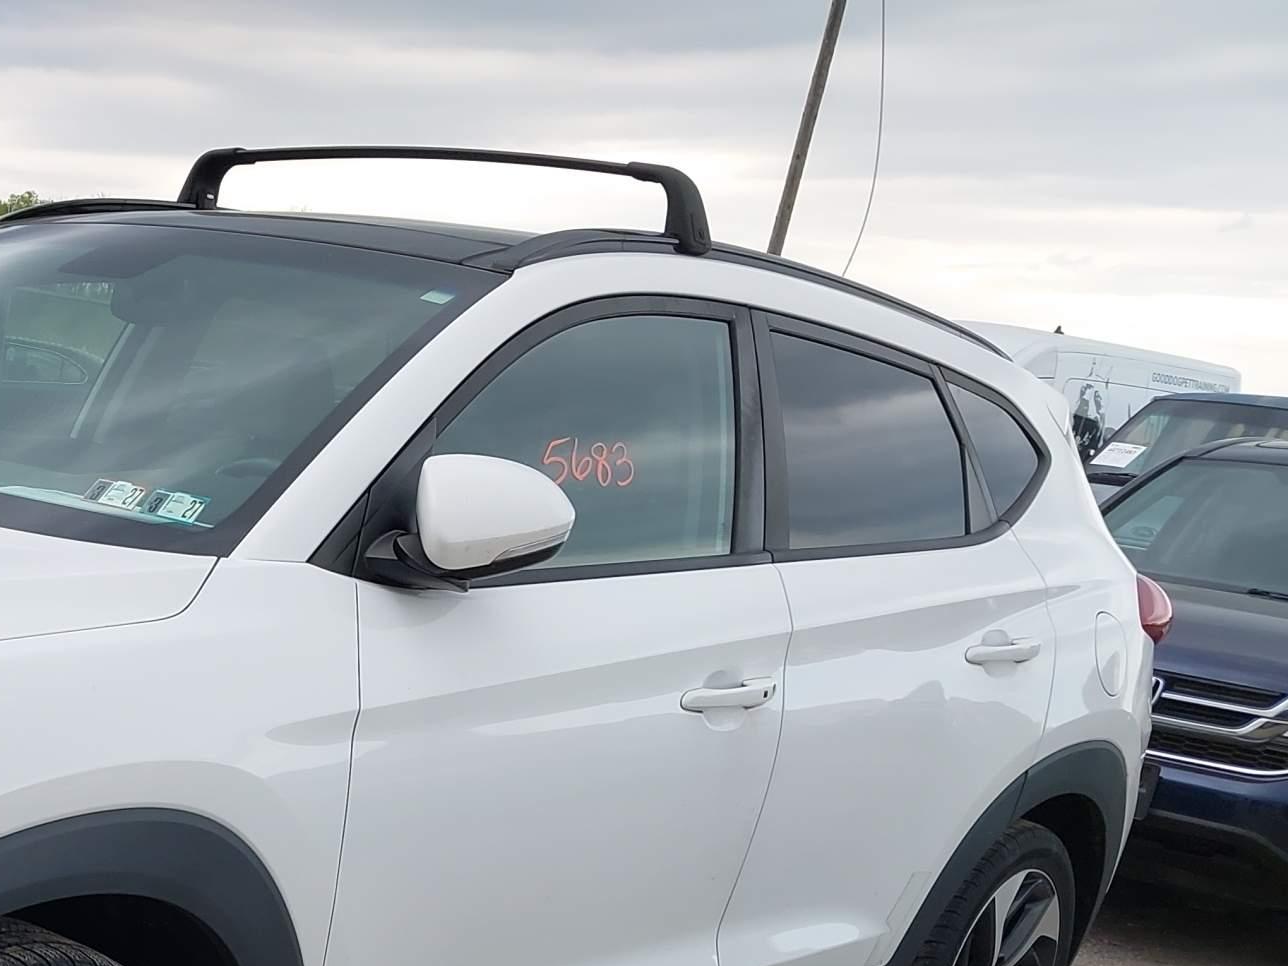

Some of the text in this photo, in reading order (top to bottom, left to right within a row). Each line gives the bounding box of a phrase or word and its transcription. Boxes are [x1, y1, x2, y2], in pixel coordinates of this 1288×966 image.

[543, 437, 635, 487] 5683
[89, 485, 145, 508] 3 27
[147, 497, 204, 521] 3 27
